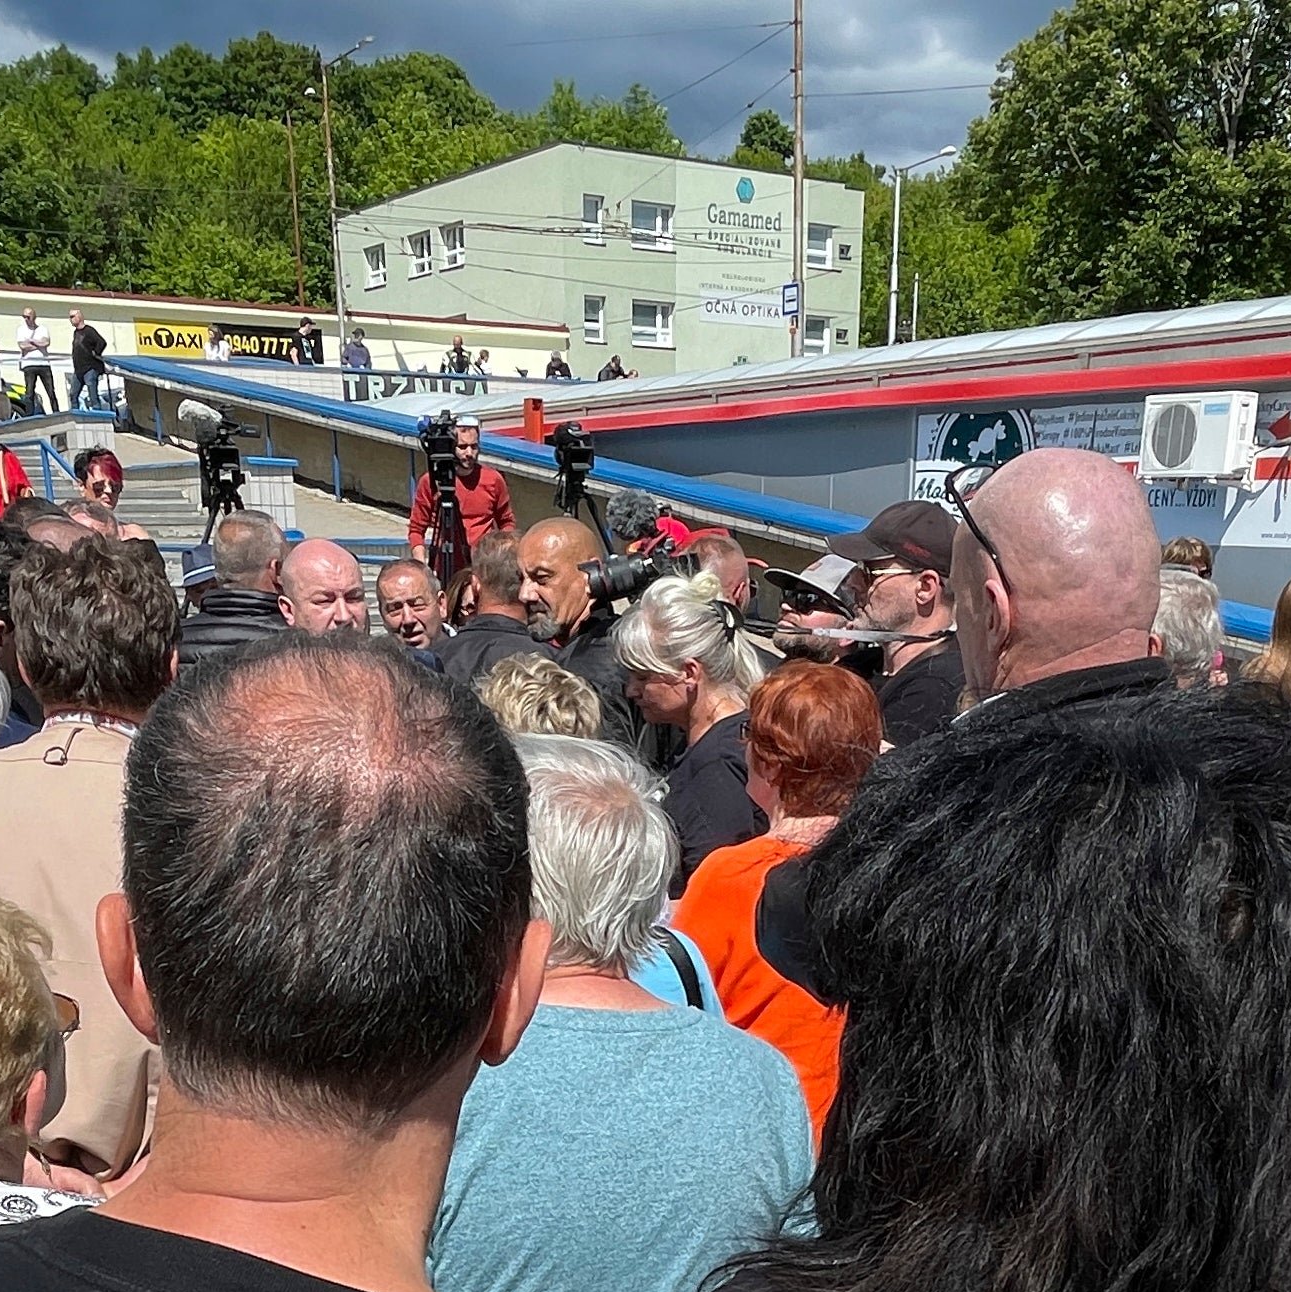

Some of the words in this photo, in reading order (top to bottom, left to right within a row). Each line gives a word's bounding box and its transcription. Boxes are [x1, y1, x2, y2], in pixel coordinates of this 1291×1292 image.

[707, 202, 782, 232] Gamamed
[705, 298, 737, 316] OČNÁ
[741, 304, 781, 320] OPTIKA
